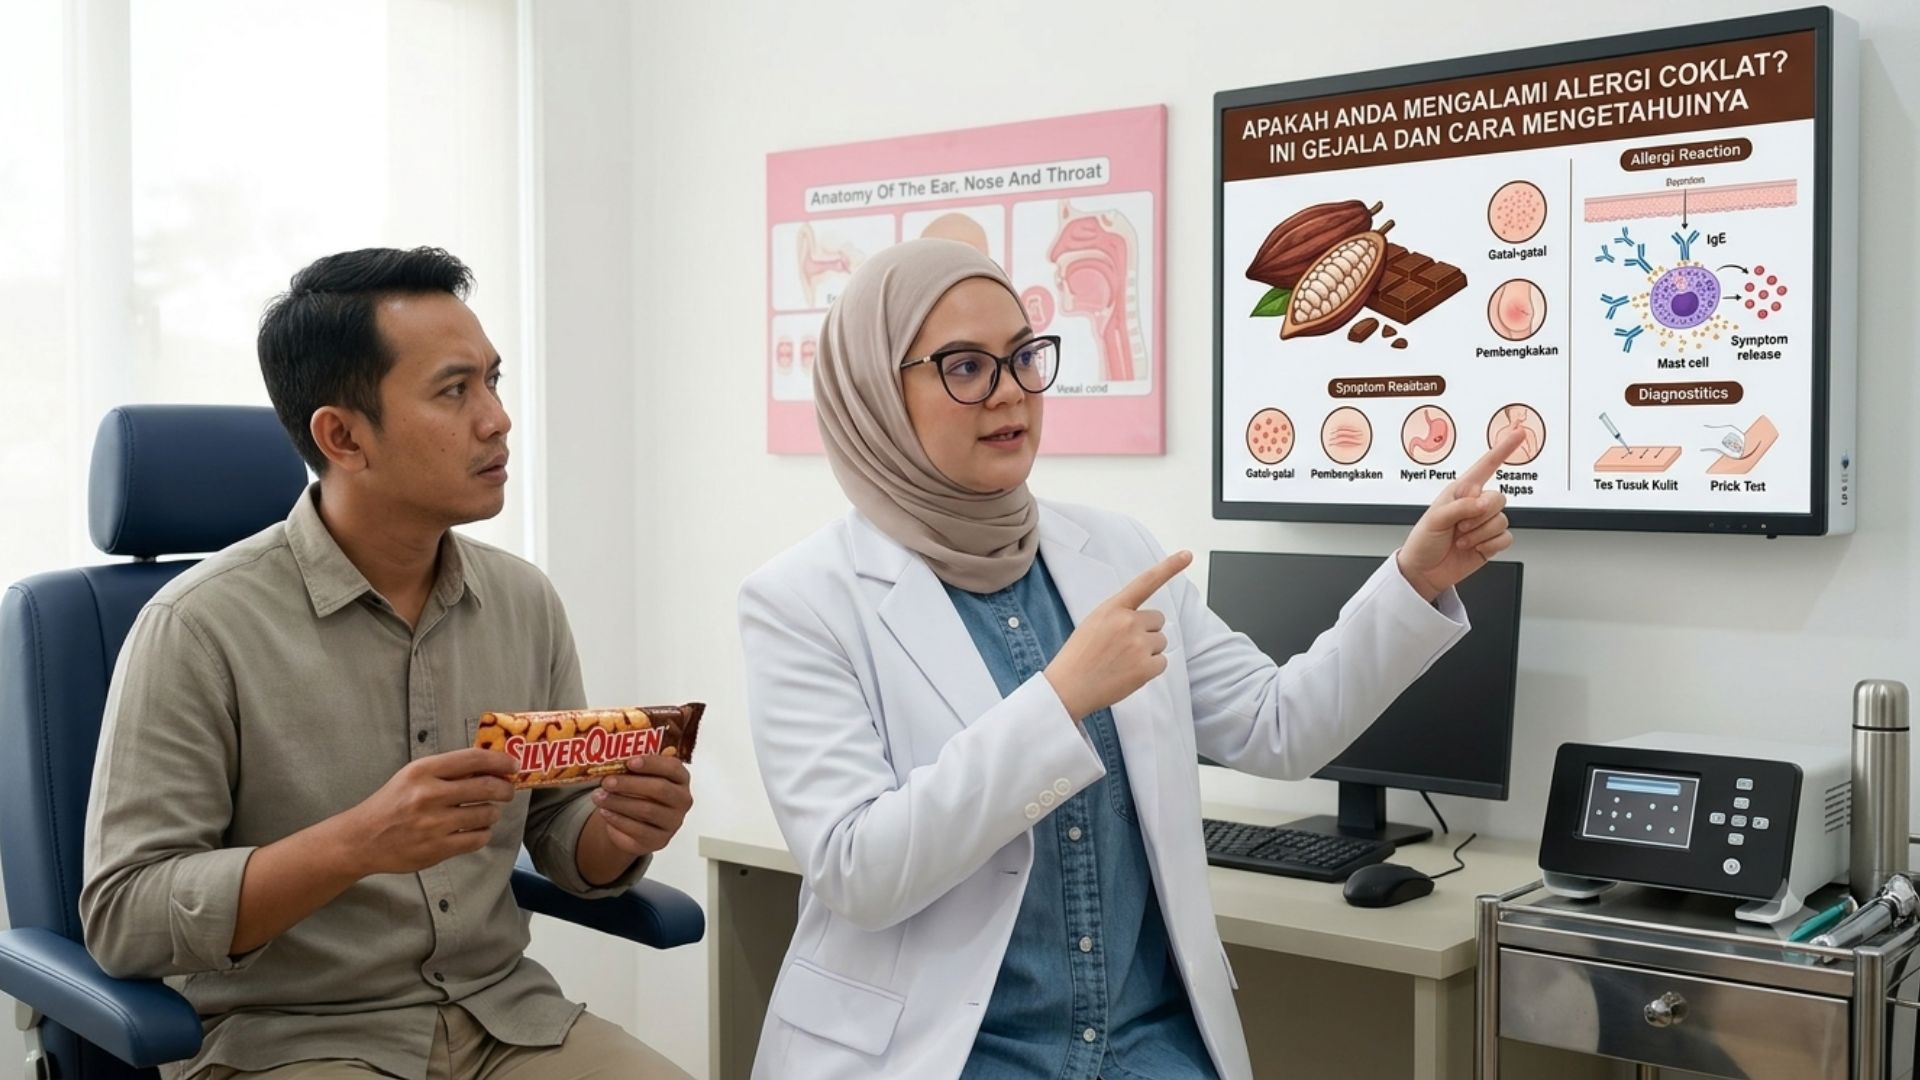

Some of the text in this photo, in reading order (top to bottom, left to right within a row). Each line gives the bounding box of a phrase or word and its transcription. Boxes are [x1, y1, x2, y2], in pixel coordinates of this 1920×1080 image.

[1242, 49, 1789, 140] APAKAH ANDA MENGALAMI ALERGI COKLAT?
[1269, 88, 1749, 163] INI GEJALA DAN CARA MENGETAHUINYA
[1630, 144, 1741, 167] Allergi Reaction
[810, 187, 873, 206] Anatomy
[877, 183, 896, 200] Of
[898, 180, 926, 198] The
[964, 174, 1004, 192] Nose
[1008, 169, 1041, 187] And
[1046, 163, 1102, 184] Throat
[1707, 232, 1727, 247] IgE
[1730, 335, 1788, 348] Symptom
[1475, 345, 1558, 359] Pembengkakan
[1737, 349, 1782, 361] release
[1657, 356, 1709, 369] Mast cell
[1639, 387, 1729, 403] Diagnostitics
[1400, 469, 1457, 482] Nyeri Perut
[1499, 483, 1533, 497] Napas
[1593, 479, 1679, 491] Tes Tusuk Kulit
[1710, 480, 1766, 492] Prick Test
